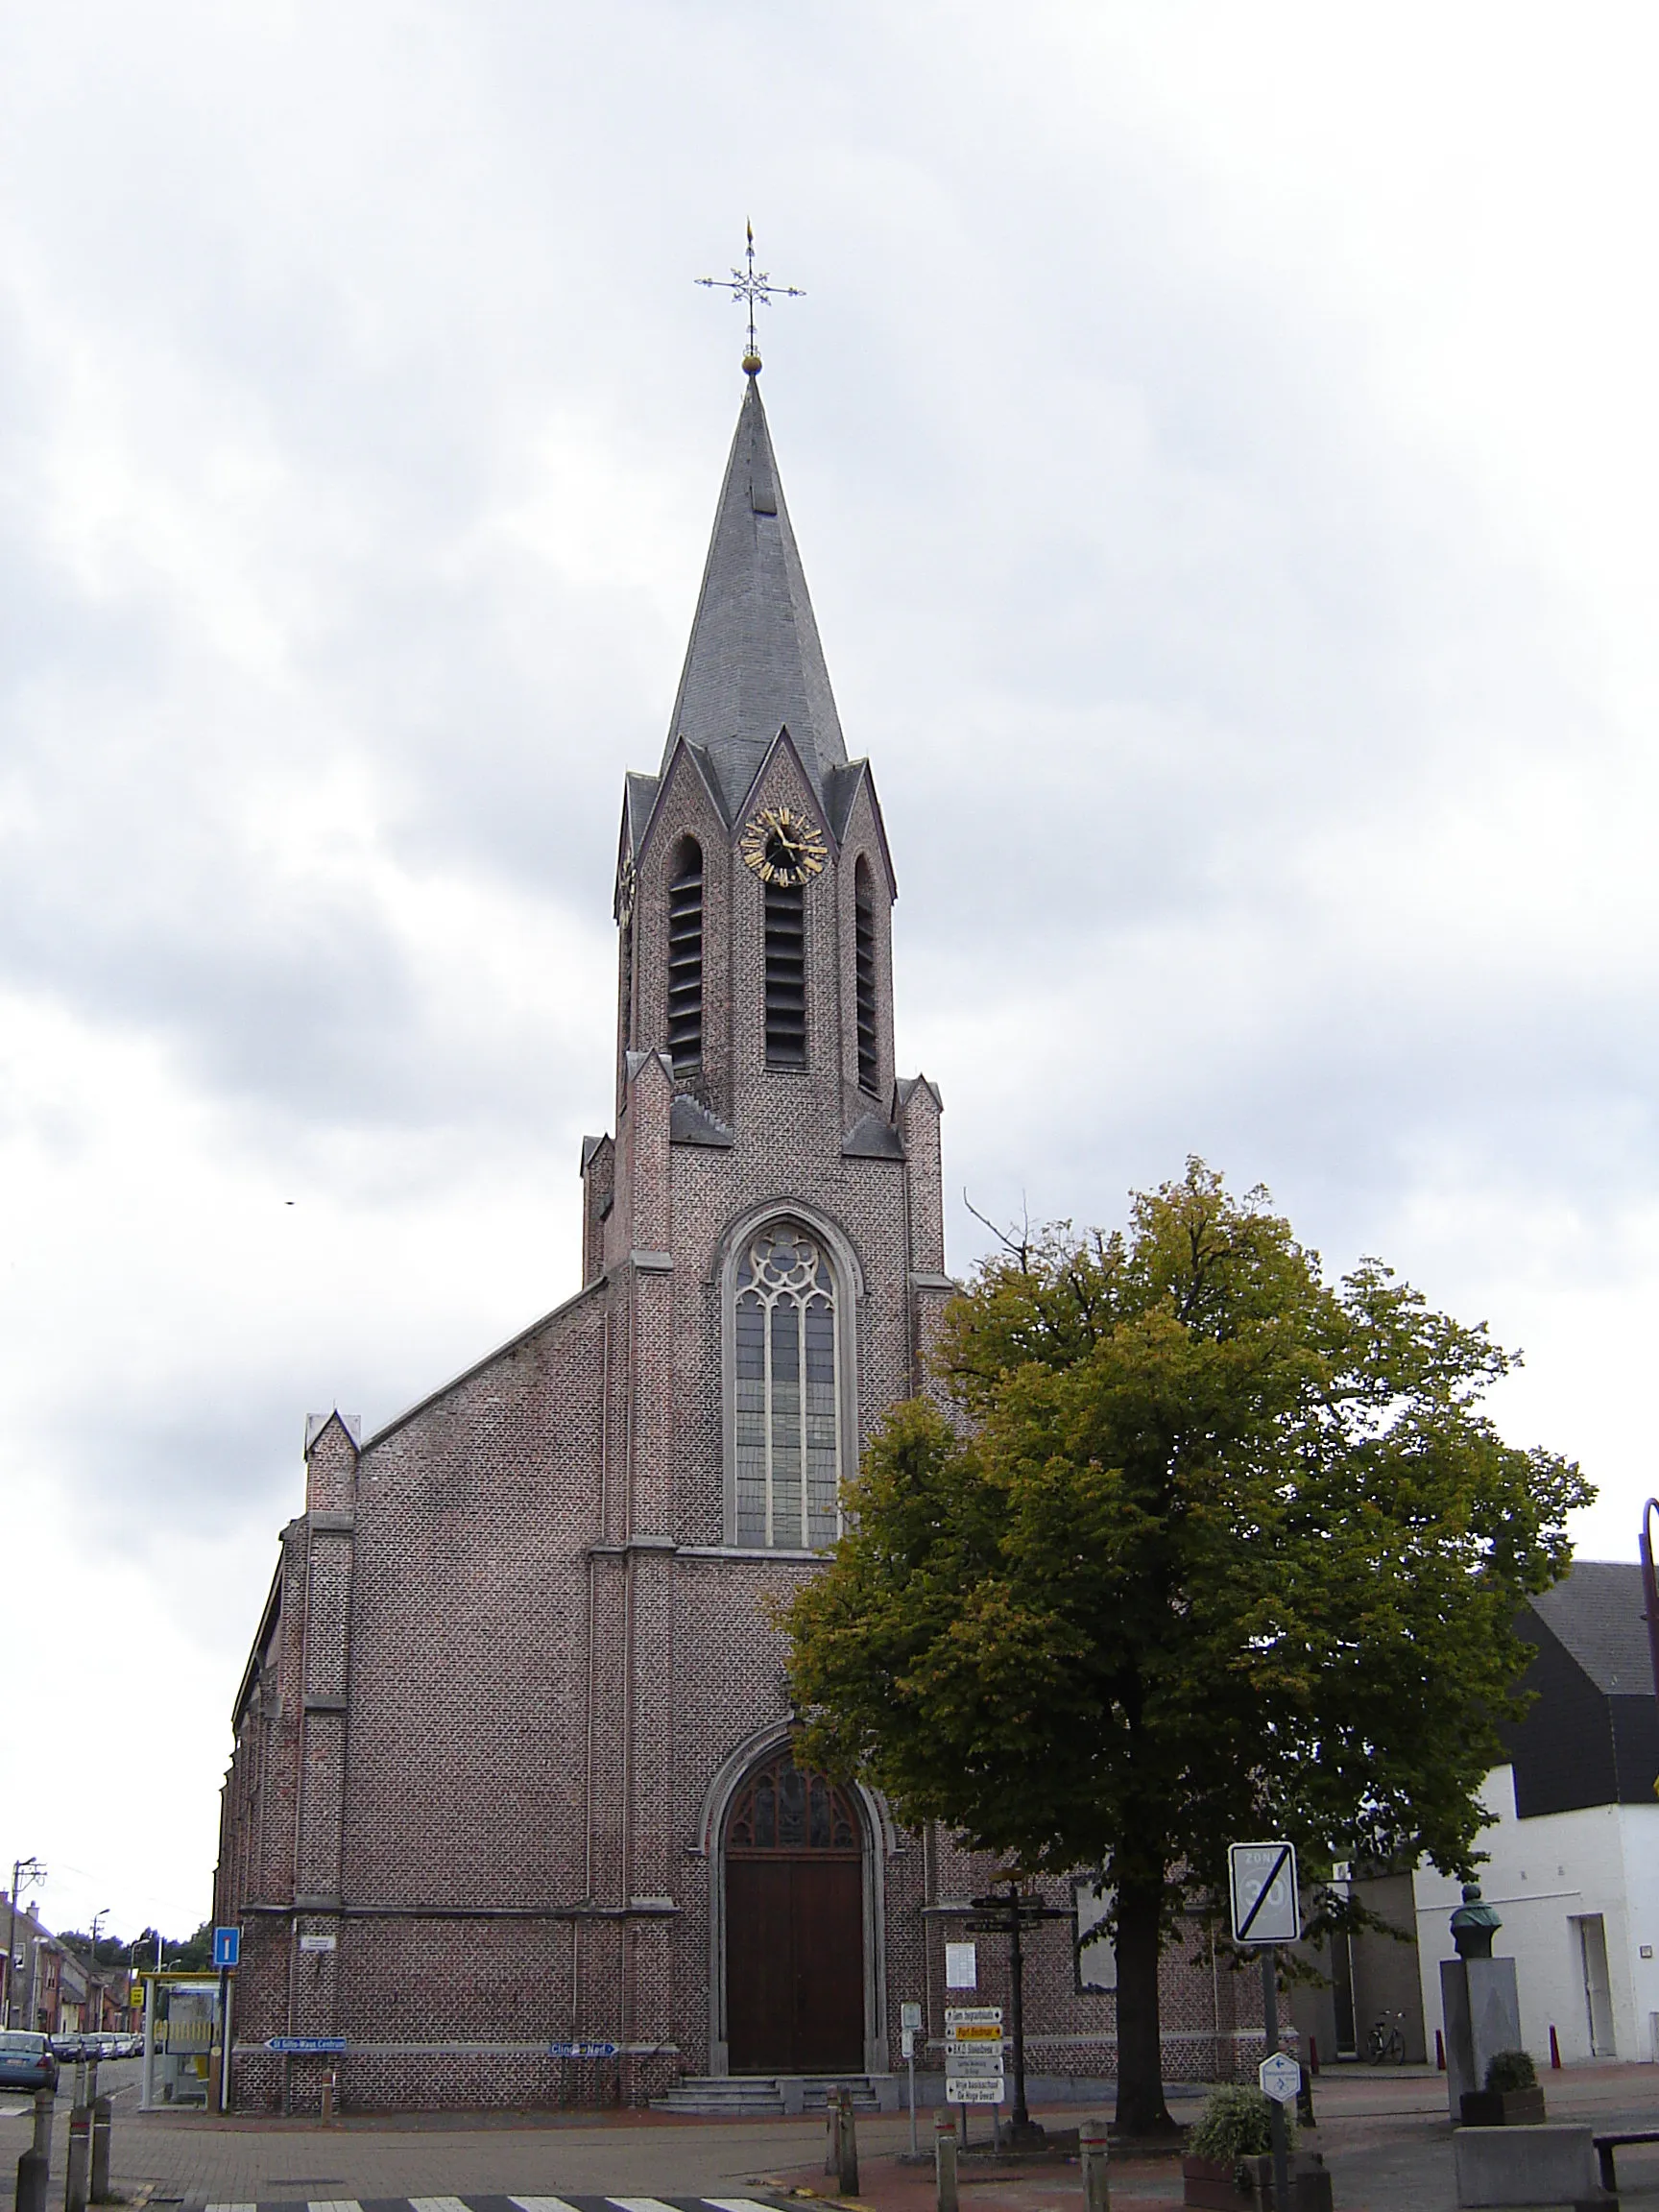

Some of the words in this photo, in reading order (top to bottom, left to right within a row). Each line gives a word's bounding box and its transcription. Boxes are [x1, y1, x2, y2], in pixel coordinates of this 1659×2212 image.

[1244, 1852, 1279, 1865] ZONE
[1244, 1878, 1285, 1907] 30
[318, 2039, 346, 2049] Centrum
